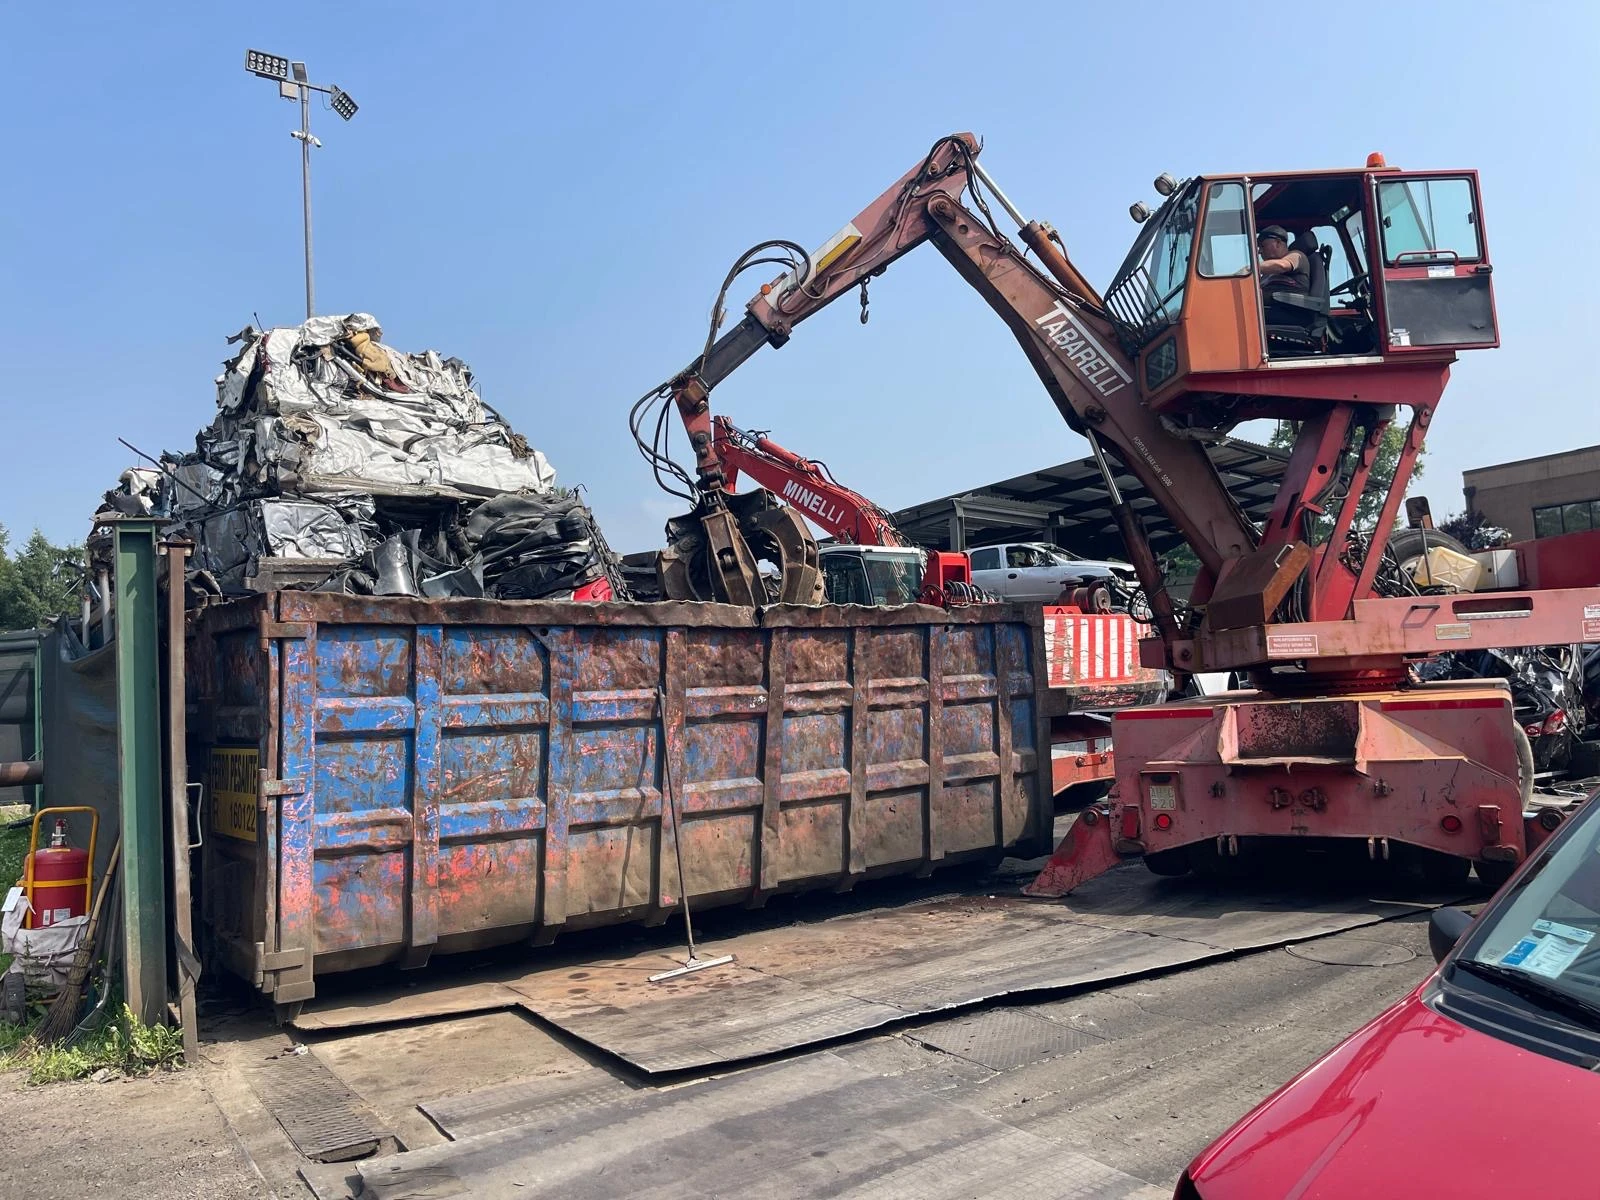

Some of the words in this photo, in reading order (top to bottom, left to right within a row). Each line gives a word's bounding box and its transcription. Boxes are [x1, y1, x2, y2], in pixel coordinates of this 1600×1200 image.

[1035, 299, 1133, 397] TABARELLI
[782, 479, 845, 525] MINELLI
[230, 753, 257, 794] PESANTE
[230, 801, 256, 833] 160122
[1151, 798, 1175, 809] 520
